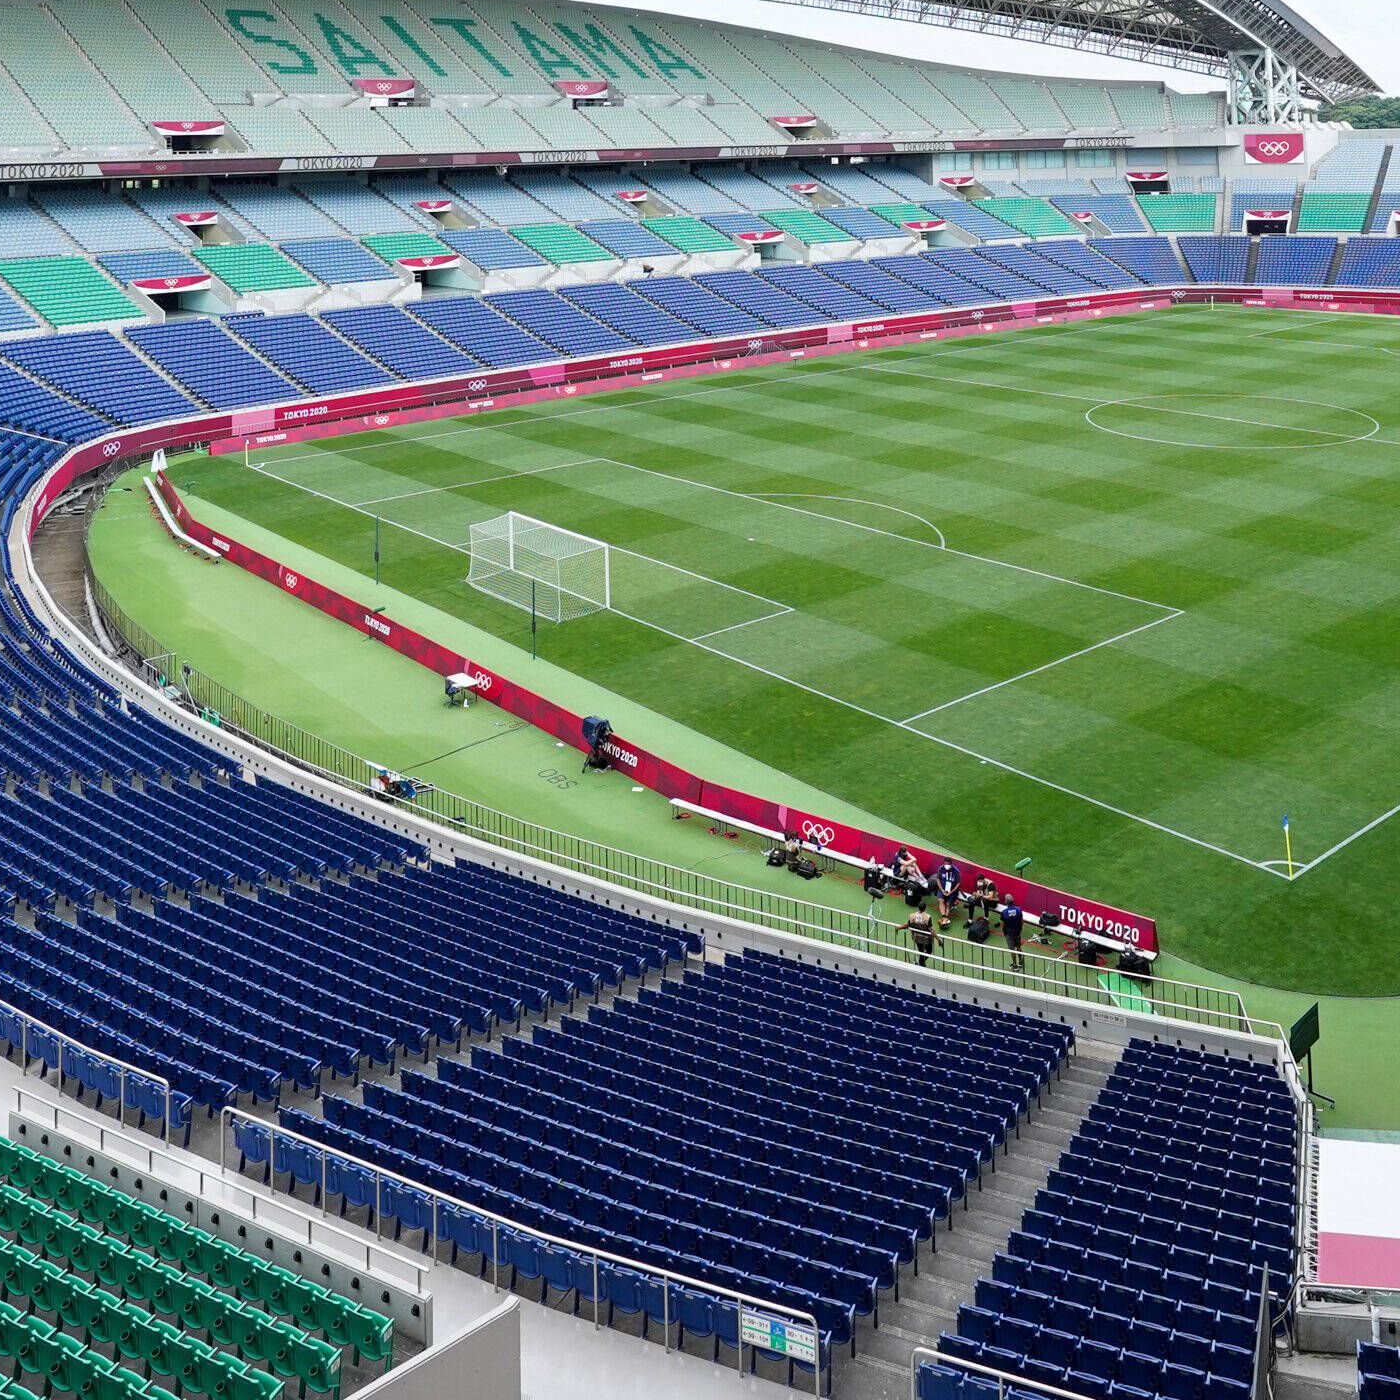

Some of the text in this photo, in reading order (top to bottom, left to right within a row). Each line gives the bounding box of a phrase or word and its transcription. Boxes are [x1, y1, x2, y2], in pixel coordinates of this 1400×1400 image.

[224, 9, 705, 79] SAITAMA
[0, 163, 84, 180] TOKYO 2020
[296, 156, 363, 170] TOKYO 2020
[283, 405, 328, 421] TOKYO 2020
[620, 750, 638, 768] 2020
[1059, 904, 1140, 943] TOKYO 2020
